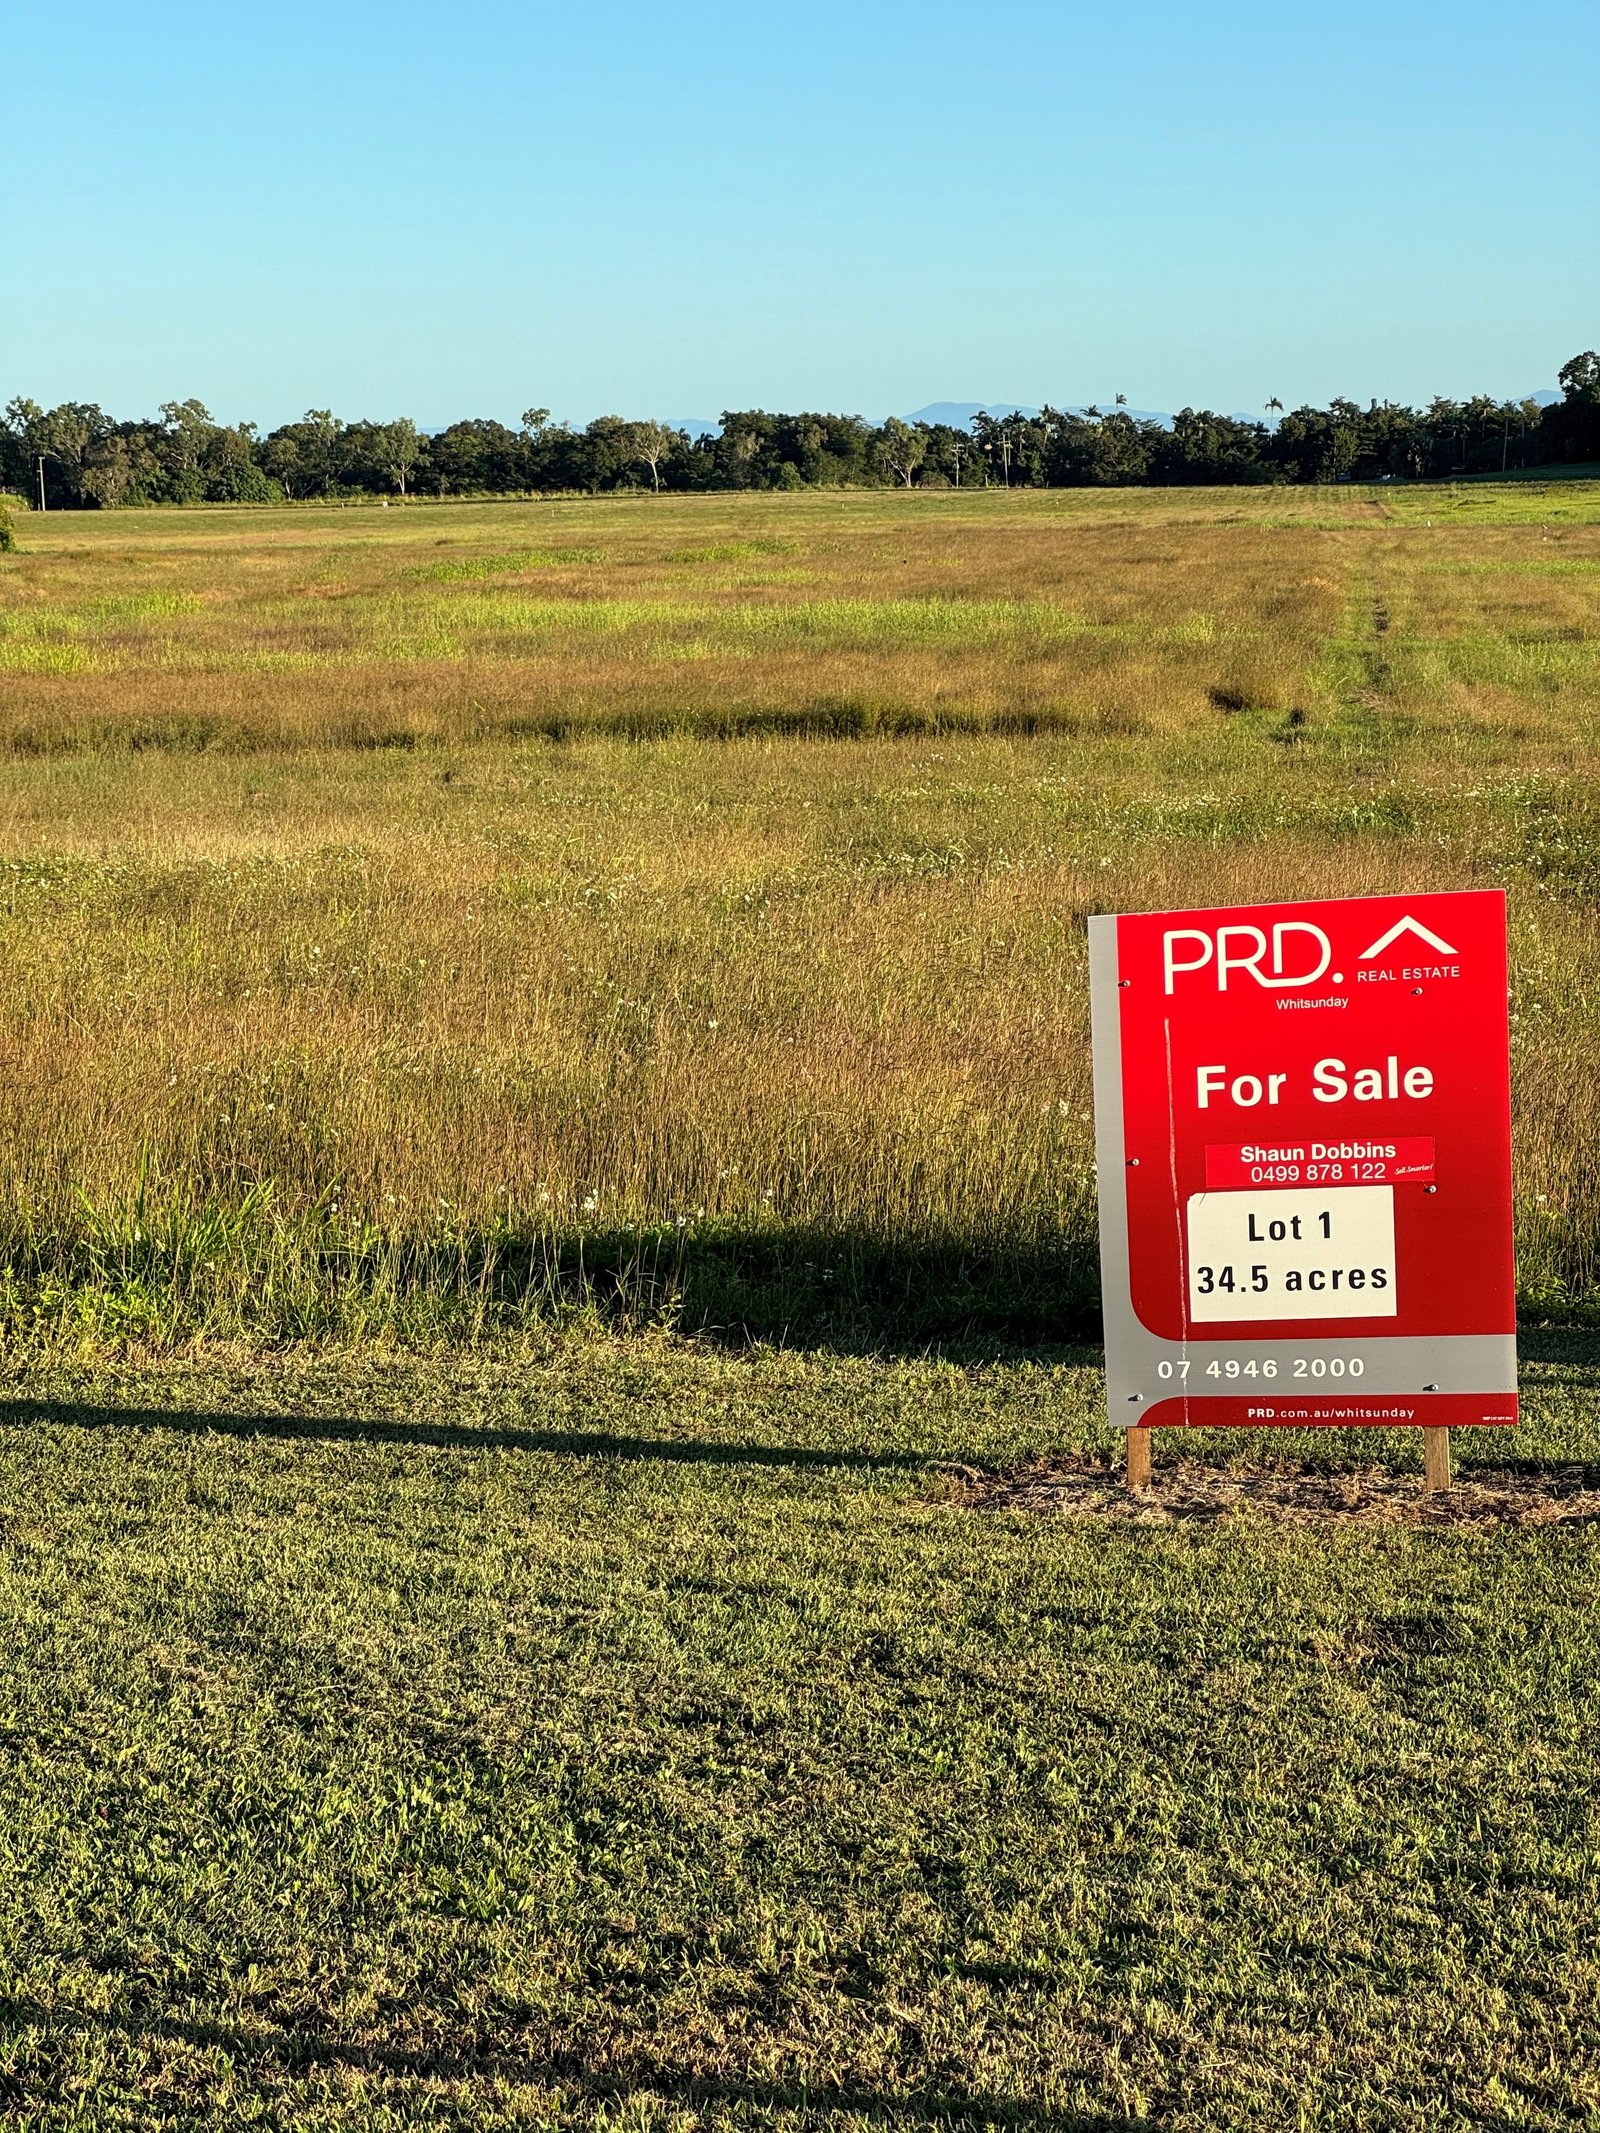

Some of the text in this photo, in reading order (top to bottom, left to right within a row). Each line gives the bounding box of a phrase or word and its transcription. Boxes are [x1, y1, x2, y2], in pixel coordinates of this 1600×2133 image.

[1163, 922, 1344, 995] PRD.
[1357, 966, 1461, 983] REAL ESTATE
[1276, 996, 1349, 1010] Whitsunday
[1196, 1056, 1434, 1109] For Sale
[1240, 1142, 1397, 1162] Shaun Dobbins
[1251, 1163, 1386, 1182] 0499 878 122
[1248, 1211, 1332, 1242] Lot 1
[1197, 1265, 1388, 1294] 34.5 acres
[1157, 1358, 1365, 1379] 07 4946 2000
[1247, 1407, 1415, 1420] PRD.com.au/whitsunday
